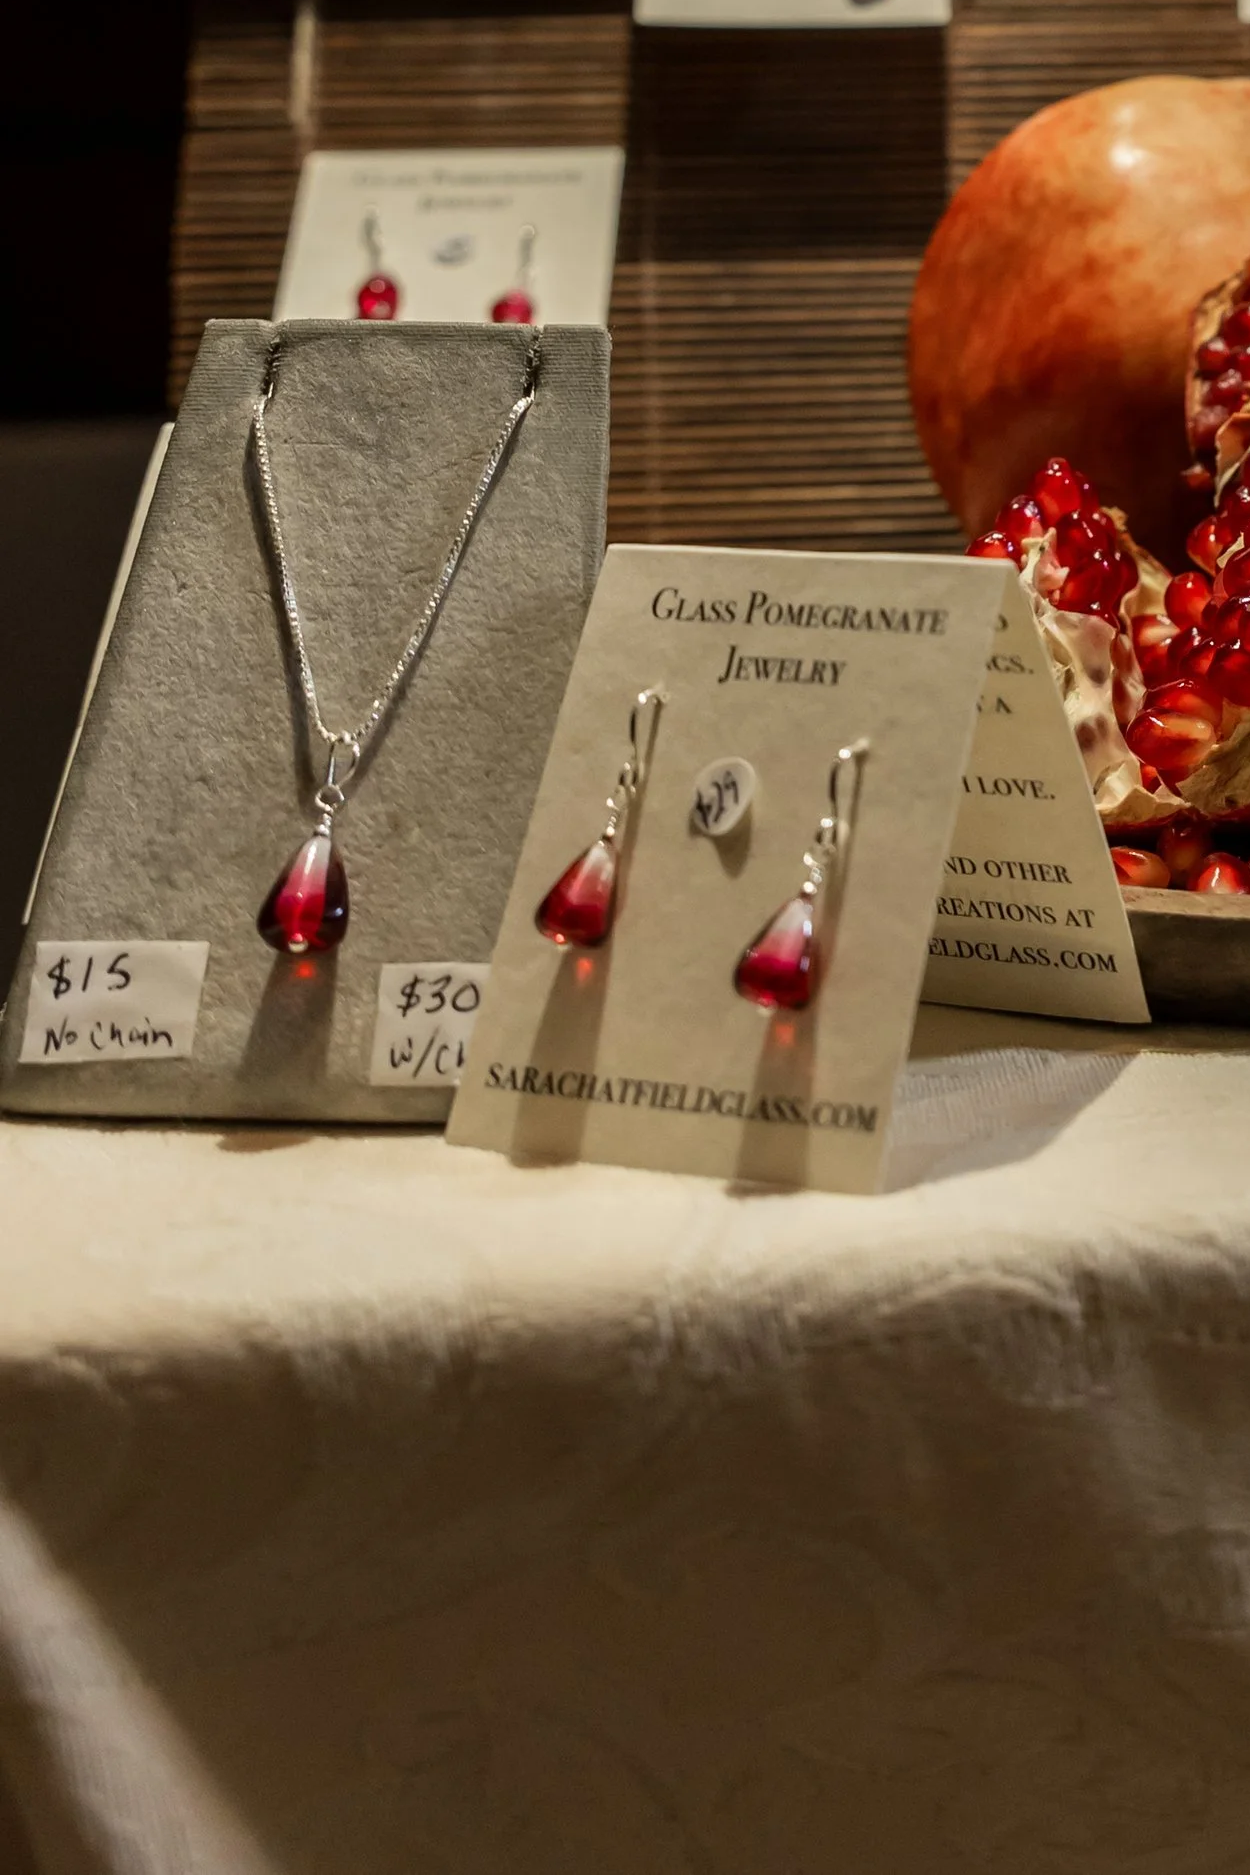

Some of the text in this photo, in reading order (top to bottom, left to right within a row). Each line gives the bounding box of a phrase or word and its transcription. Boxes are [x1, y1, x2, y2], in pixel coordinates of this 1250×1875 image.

[651, 587, 738, 624] GLASS
[744, 591, 949, 635] POMEGRANATE
[718, 645, 847, 686] JEWELRY
[977, 776, 1056, 800] LOVE.
[984, 860, 1072, 884] OTHER
[1065, 909, 1095, 928] AT
[47, 953, 131, 1000] $15
[396, 974, 480, 1016] $30
[44, 1025, 76, 1055] No
[484, 1063, 878, 1133] SARACHATFIELDGLASS.COM
